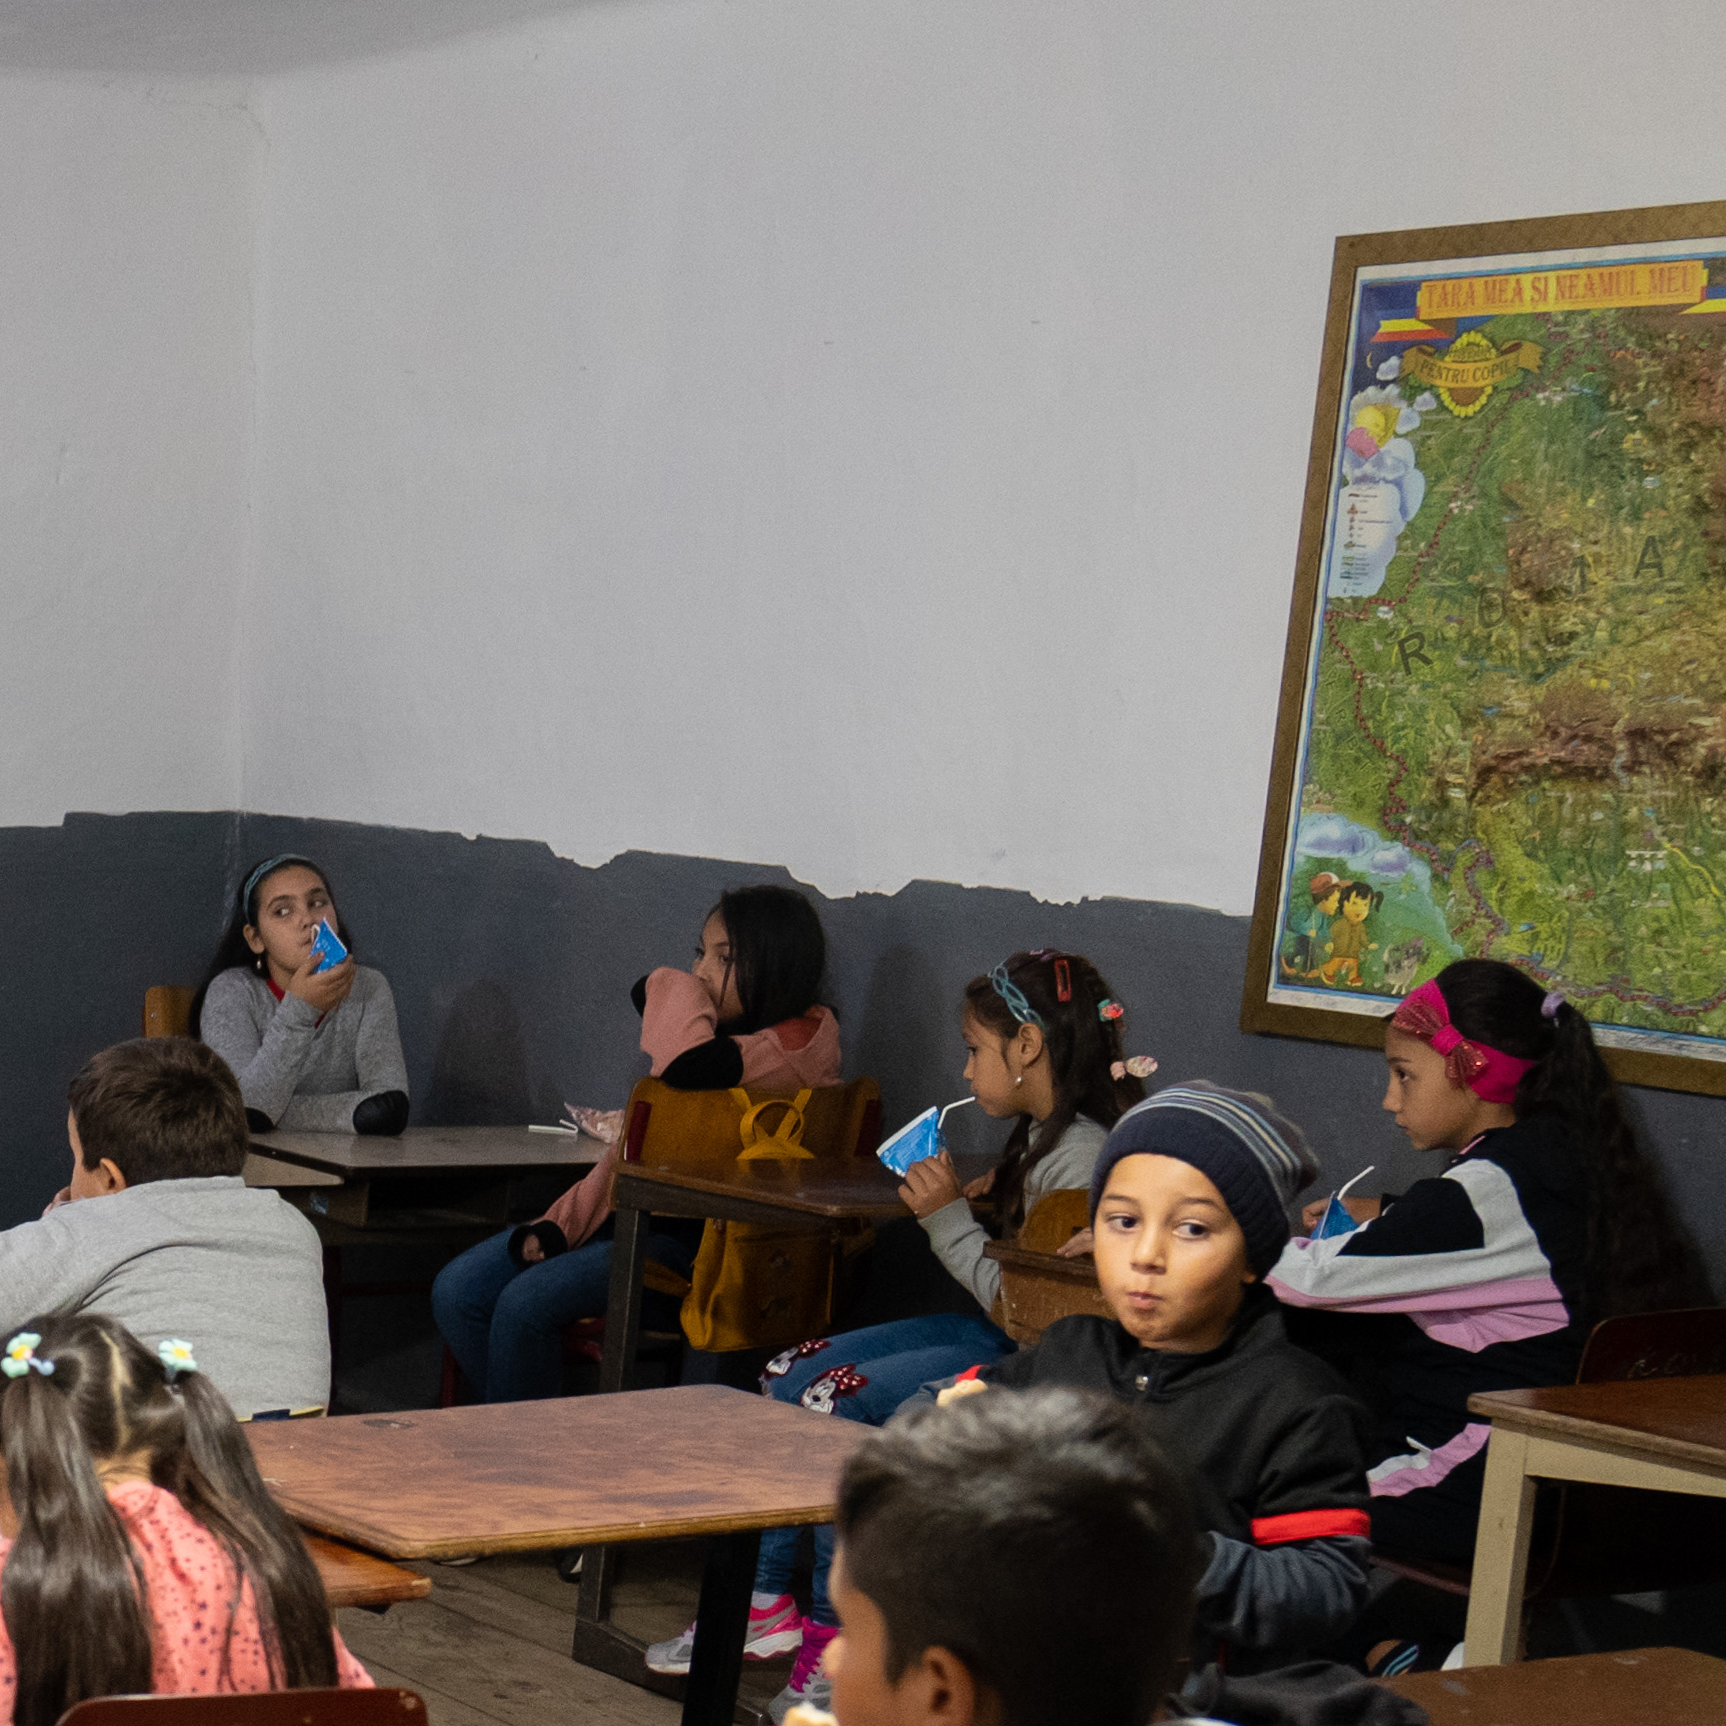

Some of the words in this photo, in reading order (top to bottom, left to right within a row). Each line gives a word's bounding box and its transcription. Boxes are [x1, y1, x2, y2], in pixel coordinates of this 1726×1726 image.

[1483, 278, 1525, 305] MEA
[1555, 269, 1641, 303] NEAMUL
[1649, 264, 1698, 295] MEU
[1420, 359, 1470, 384] PENTRU
